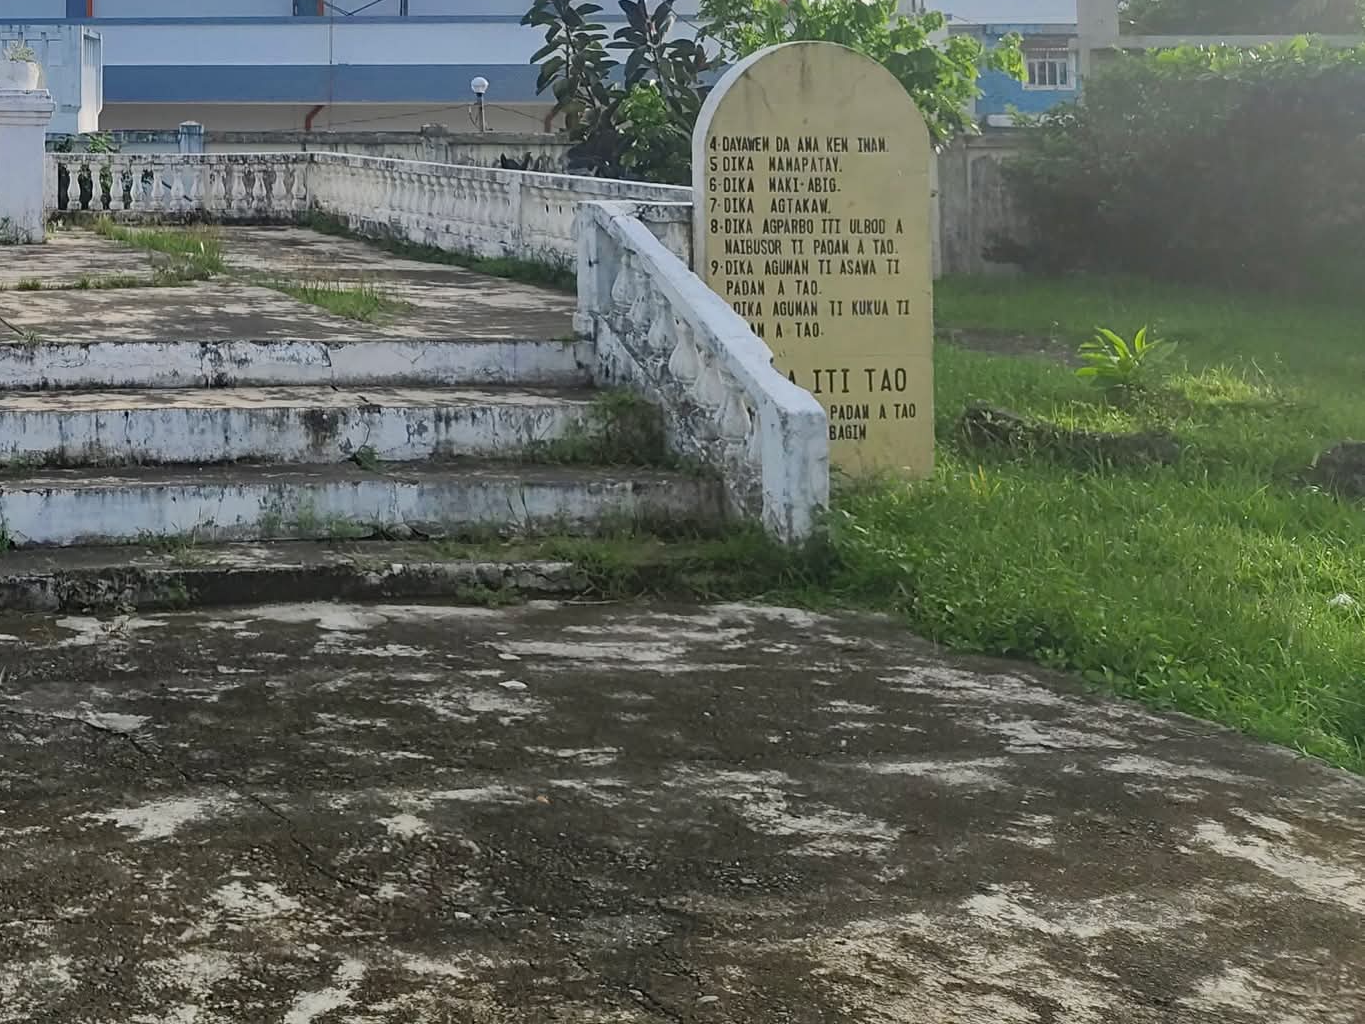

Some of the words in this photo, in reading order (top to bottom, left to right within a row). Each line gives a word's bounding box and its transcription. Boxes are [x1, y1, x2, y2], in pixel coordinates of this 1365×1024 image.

[776, 136, 789, 152] DA
[723, 156, 754, 171] DIKA
[724, 177, 754, 192] DIKA
[724, 198, 754, 213] DIKA
[725, 218, 753, 234] DIKA
[763, 219, 813, 234] AGPARBO
[822, 219, 840, 234] ITI
[850, 219, 885, 234] ULBOD
[896, 219, 903, 234] A
[791, 239, 803, 254] TI
[858, 239, 864, 254] A
[726, 260, 753, 275] DIKA
[818, 259, 831, 274] TI
[840, 260, 876, 275] ASAWA
[887, 259, 899, 274] TI
[778, 280, 784, 295] A
[829, 301, 842, 316] TI
[852, 300, 888, 315] KUKUA
[897, 300, 909, 315] TI
[776, 323, 782, 338] A
[813, 369, 849, 393] ITI
[864, 368, 906, 392] TAO
[879, 404, 886, 419] A
[894, 403, 915, 419] TAO
